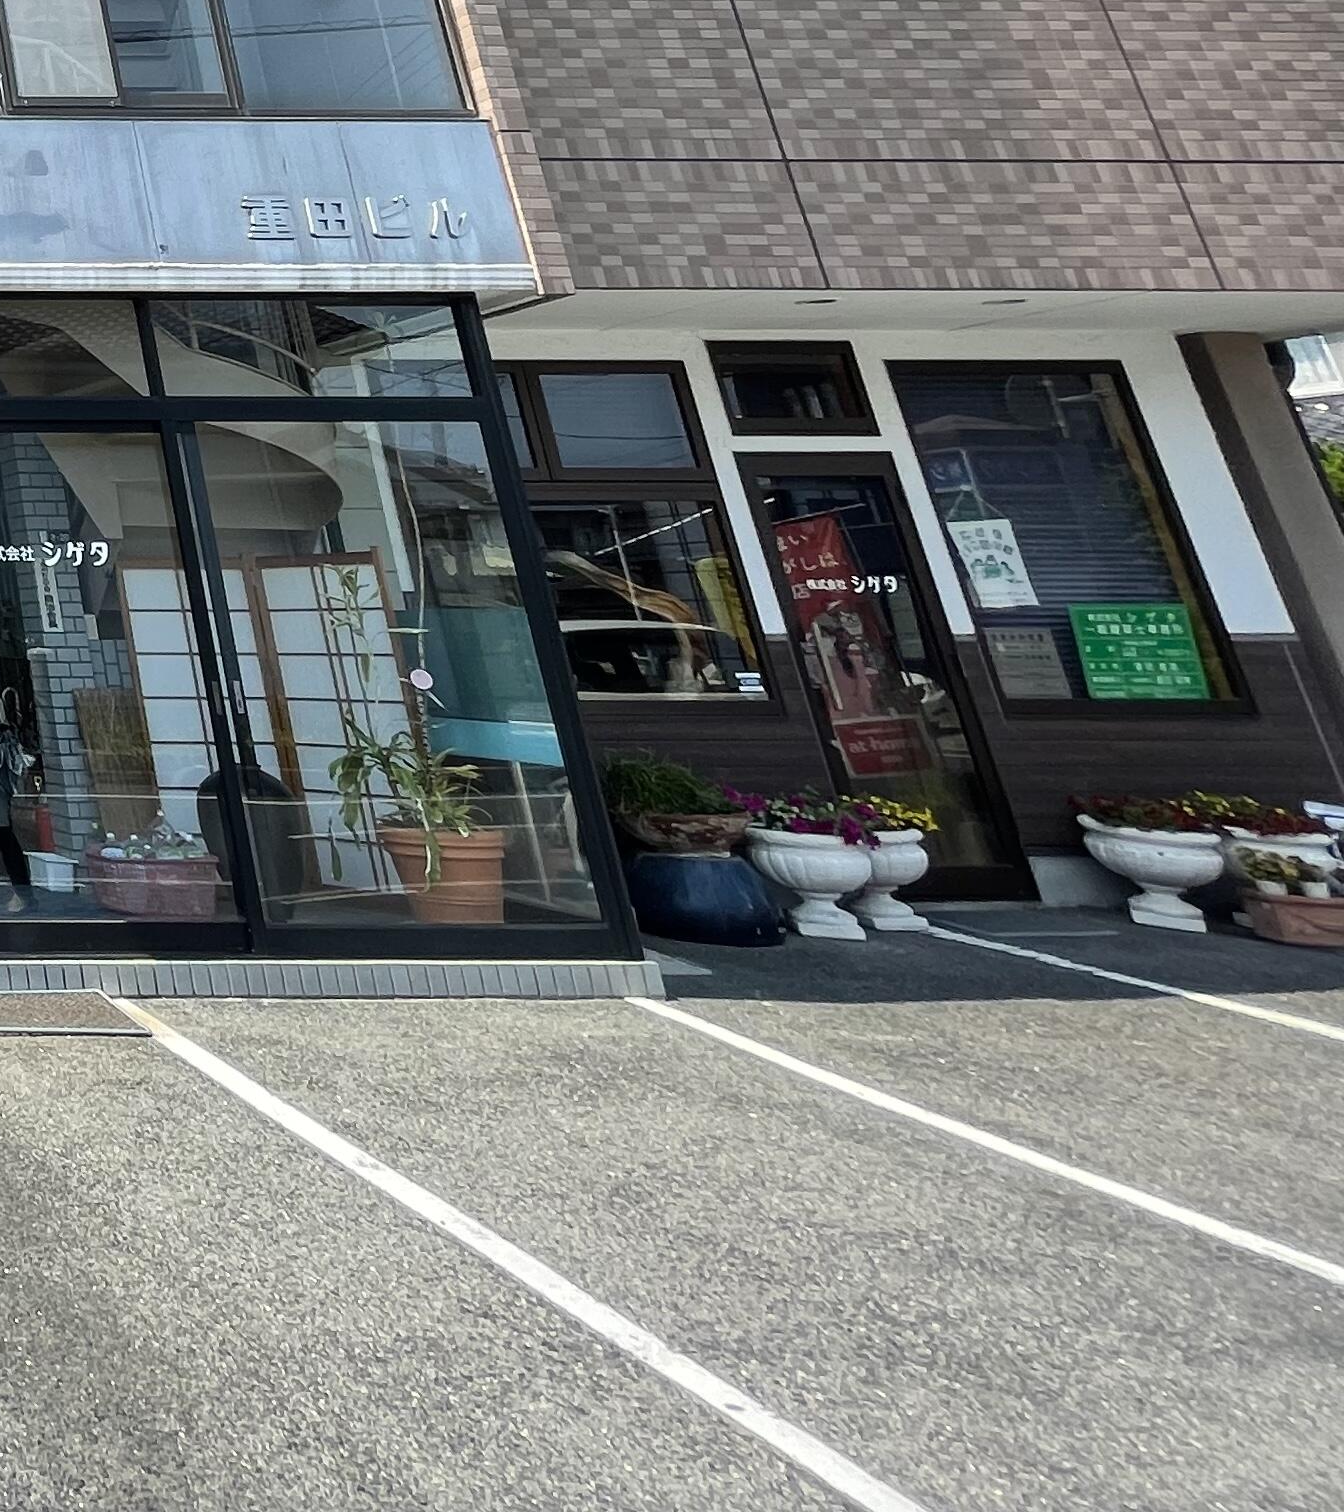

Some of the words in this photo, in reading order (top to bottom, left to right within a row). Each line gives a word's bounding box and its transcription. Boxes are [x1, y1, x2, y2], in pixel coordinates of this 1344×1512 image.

[240, 194, 469, 240] 重田ビル
[40, 541, 109, 567] シゲタ
[850, 575, 899, 593] シゲタ
